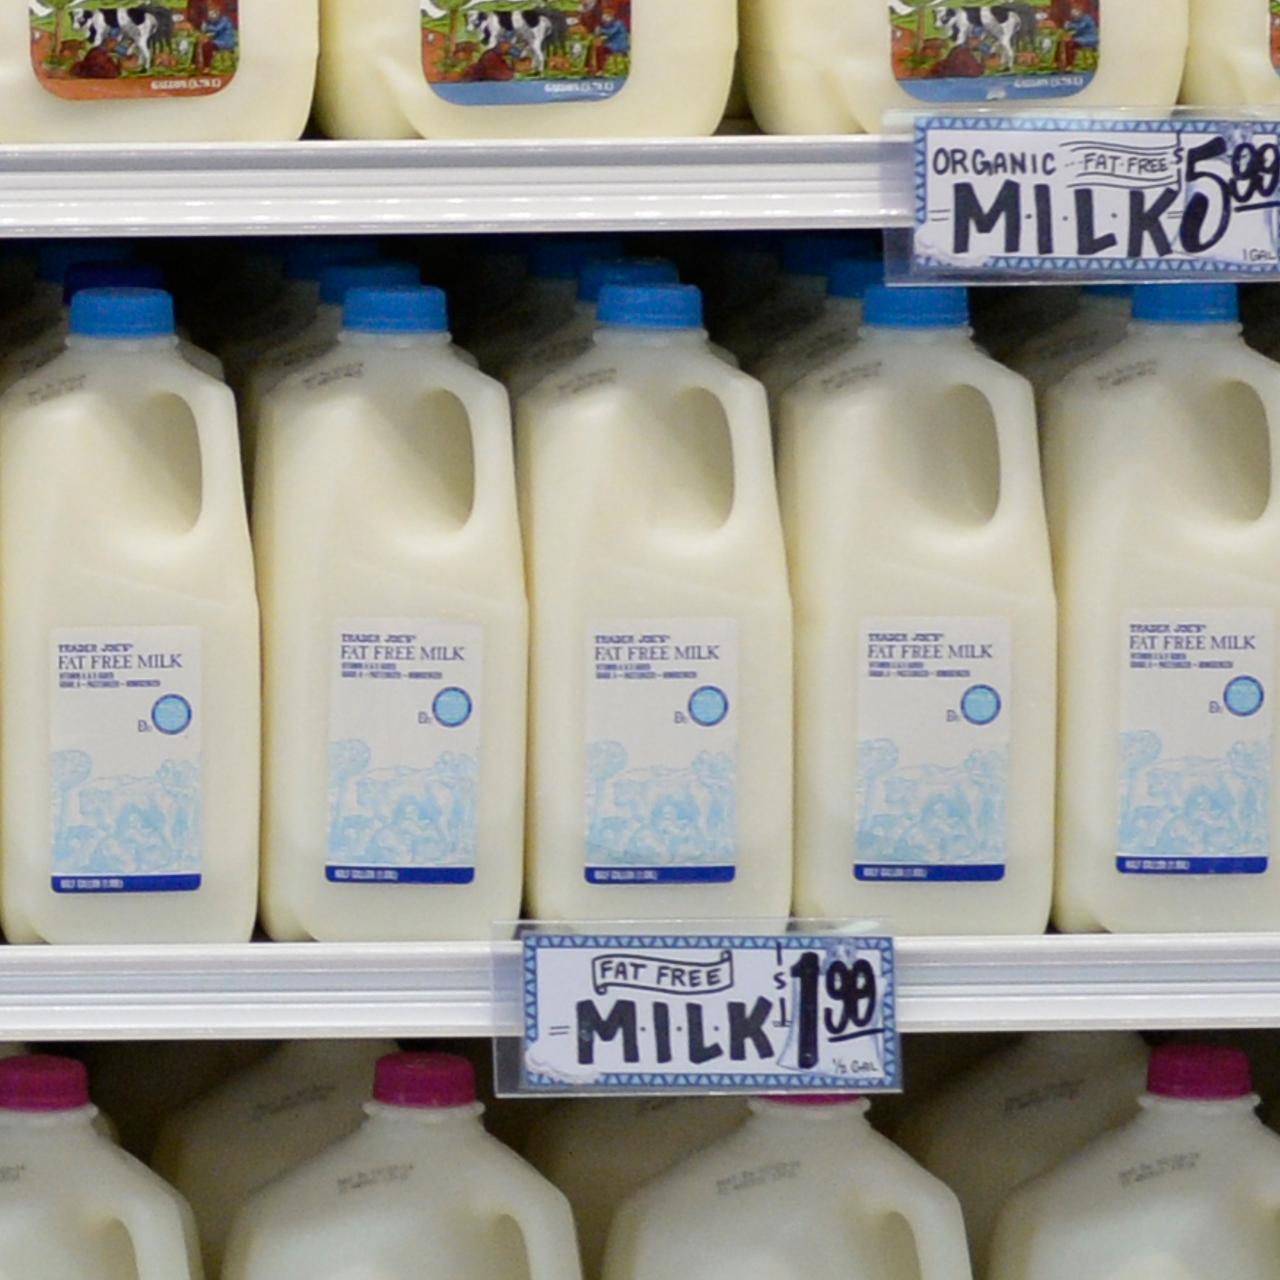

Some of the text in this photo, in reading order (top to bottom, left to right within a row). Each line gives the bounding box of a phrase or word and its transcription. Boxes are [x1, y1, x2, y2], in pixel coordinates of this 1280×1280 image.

[932, 147, 1057, 177] ORGANIC
[58, 654, 183, 670] FAT FREE MILK
[599, 960, 723, 988] FAT FREE
